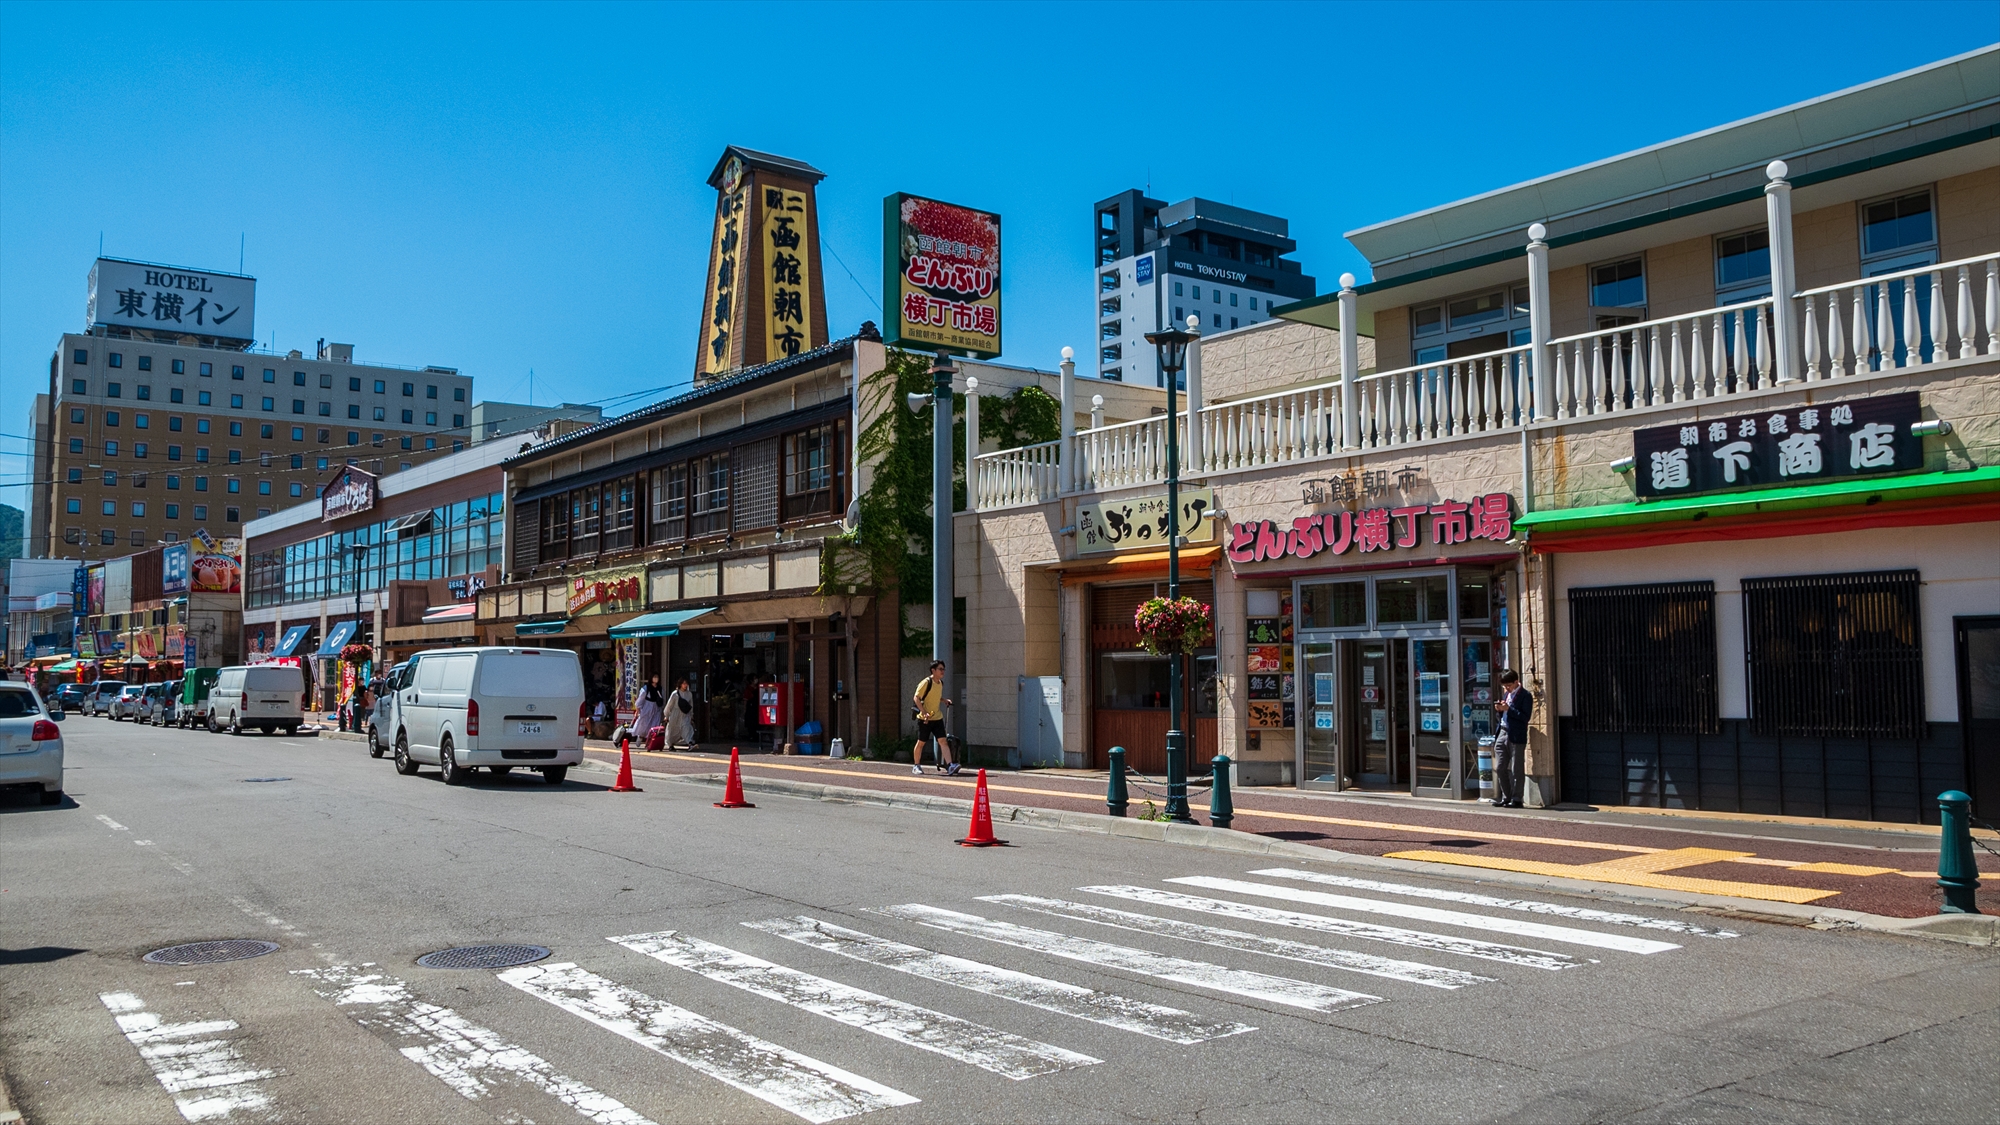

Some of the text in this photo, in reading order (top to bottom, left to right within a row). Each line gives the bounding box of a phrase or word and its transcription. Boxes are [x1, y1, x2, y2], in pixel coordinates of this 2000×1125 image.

[918, 235, 984, 261] 函館朝市
[144, 270, 213, 293] HOTEL
[906, 255, 992, 298] どんぶり
[1137, 263, 1151, 272] TOKYU
[1137, 269, 1151, 279] STAY
[1174, 261, 1194, 271] HOTEL
[771, 216, 805, 356] 函館朝市
[114, 288, 240, 326] 東横イン
[903, 292, 997, 336] 横丁市場
[908, 328, 992, 349] 函館朝市第一商業協同組合
[1679, 405, 1853, 446] 朝市お食事処
[1651, 422, 1896, 490] 道下商店
[1300, 464, 1422, 505] 函館朝市
[1138, 499, 1170, 514] 朝市食
[1080, 511, 1097, 545] 函館
[1229, 493, 1513, 563] どんぶり横丁市場
[978, 787, 987, 821] 駐車禁止
